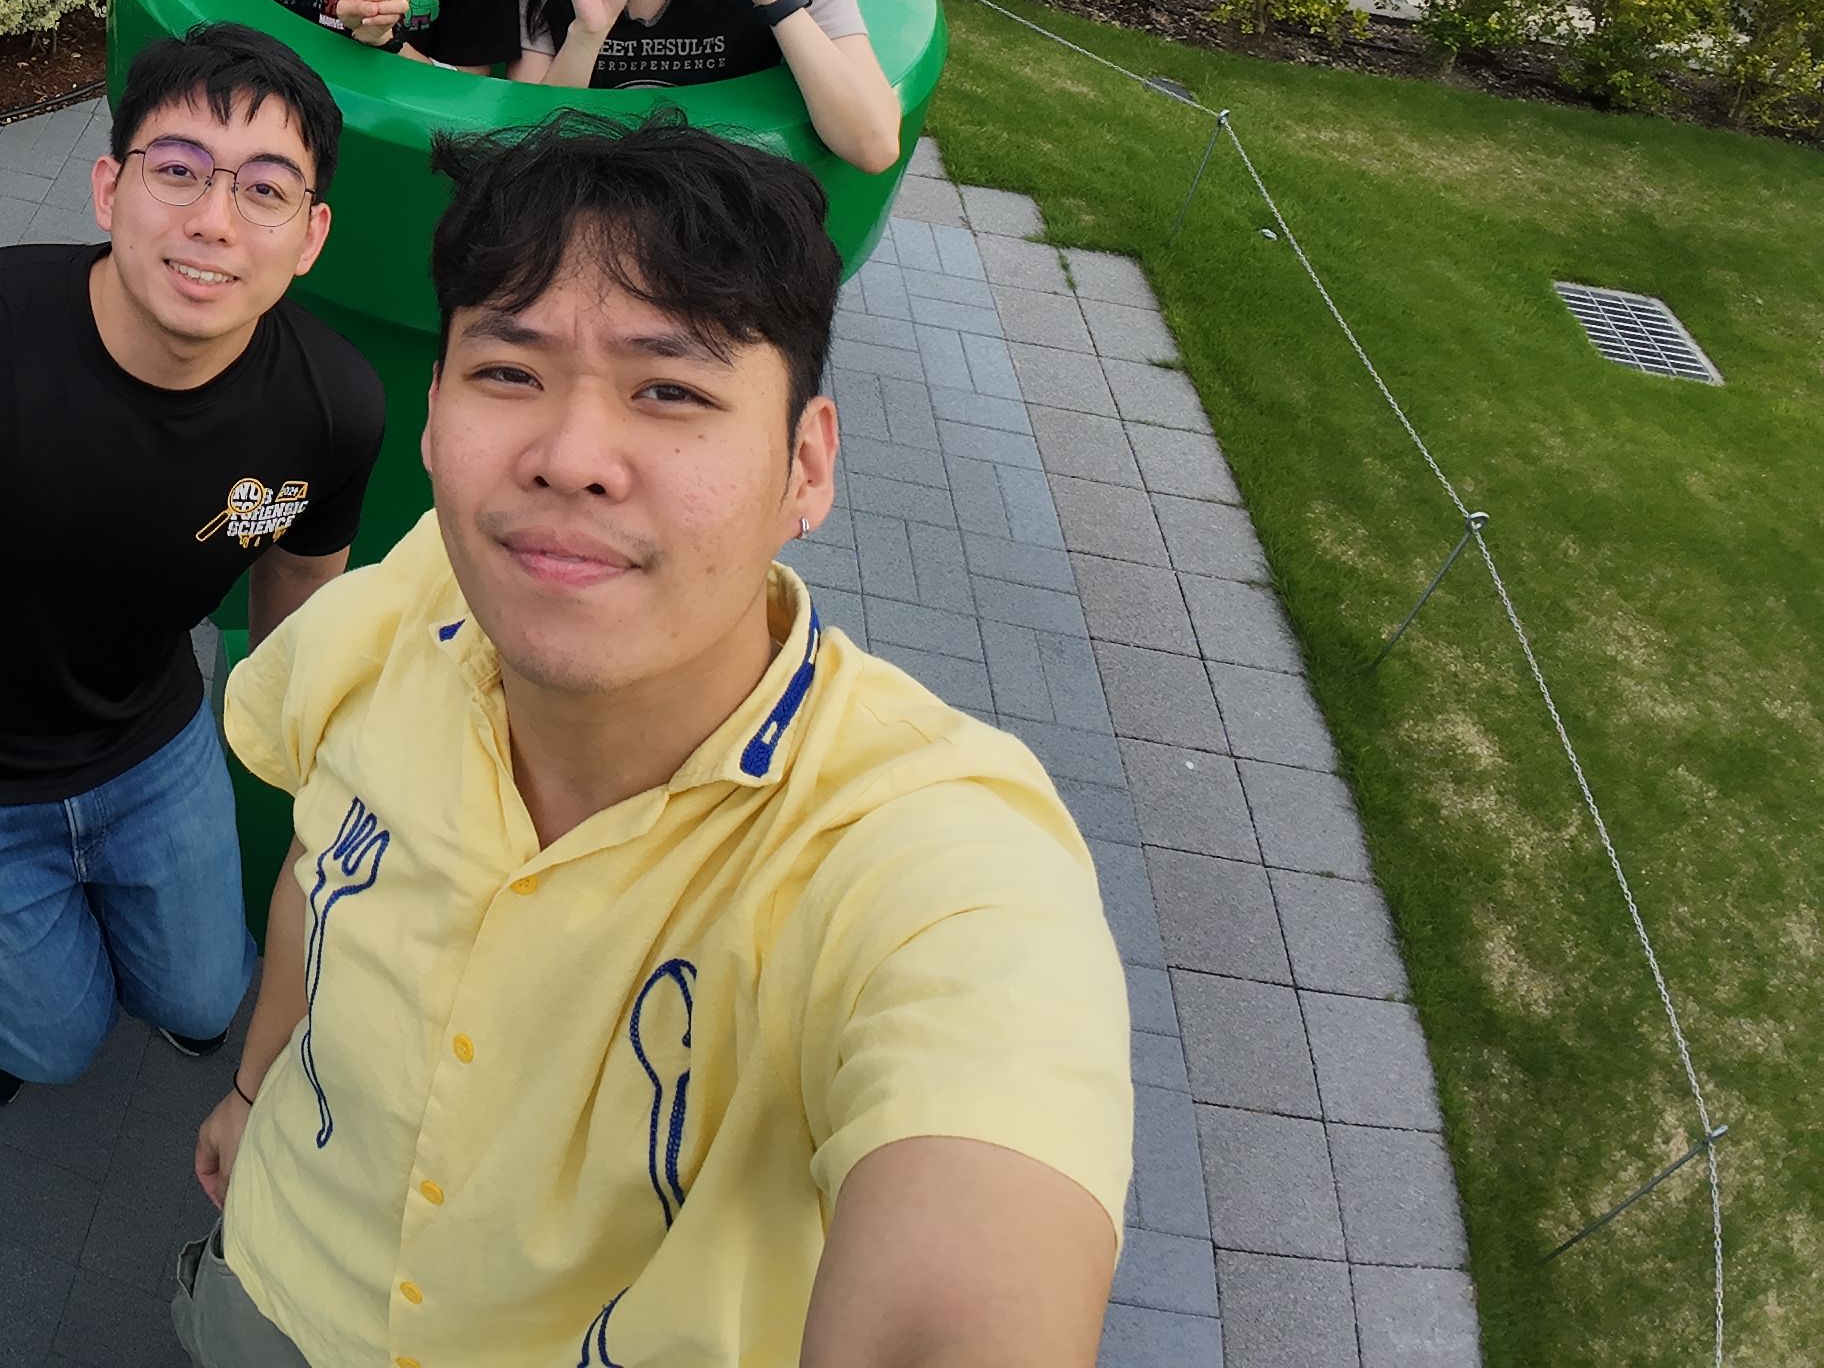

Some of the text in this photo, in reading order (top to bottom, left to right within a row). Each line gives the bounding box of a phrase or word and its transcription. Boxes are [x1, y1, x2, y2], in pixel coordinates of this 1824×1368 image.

[641, 35, 725, 56] RESULTS
[597, 57, 726, 71] ERDEPENDENCE
[227, 514, 296, 537] SCIENCE
